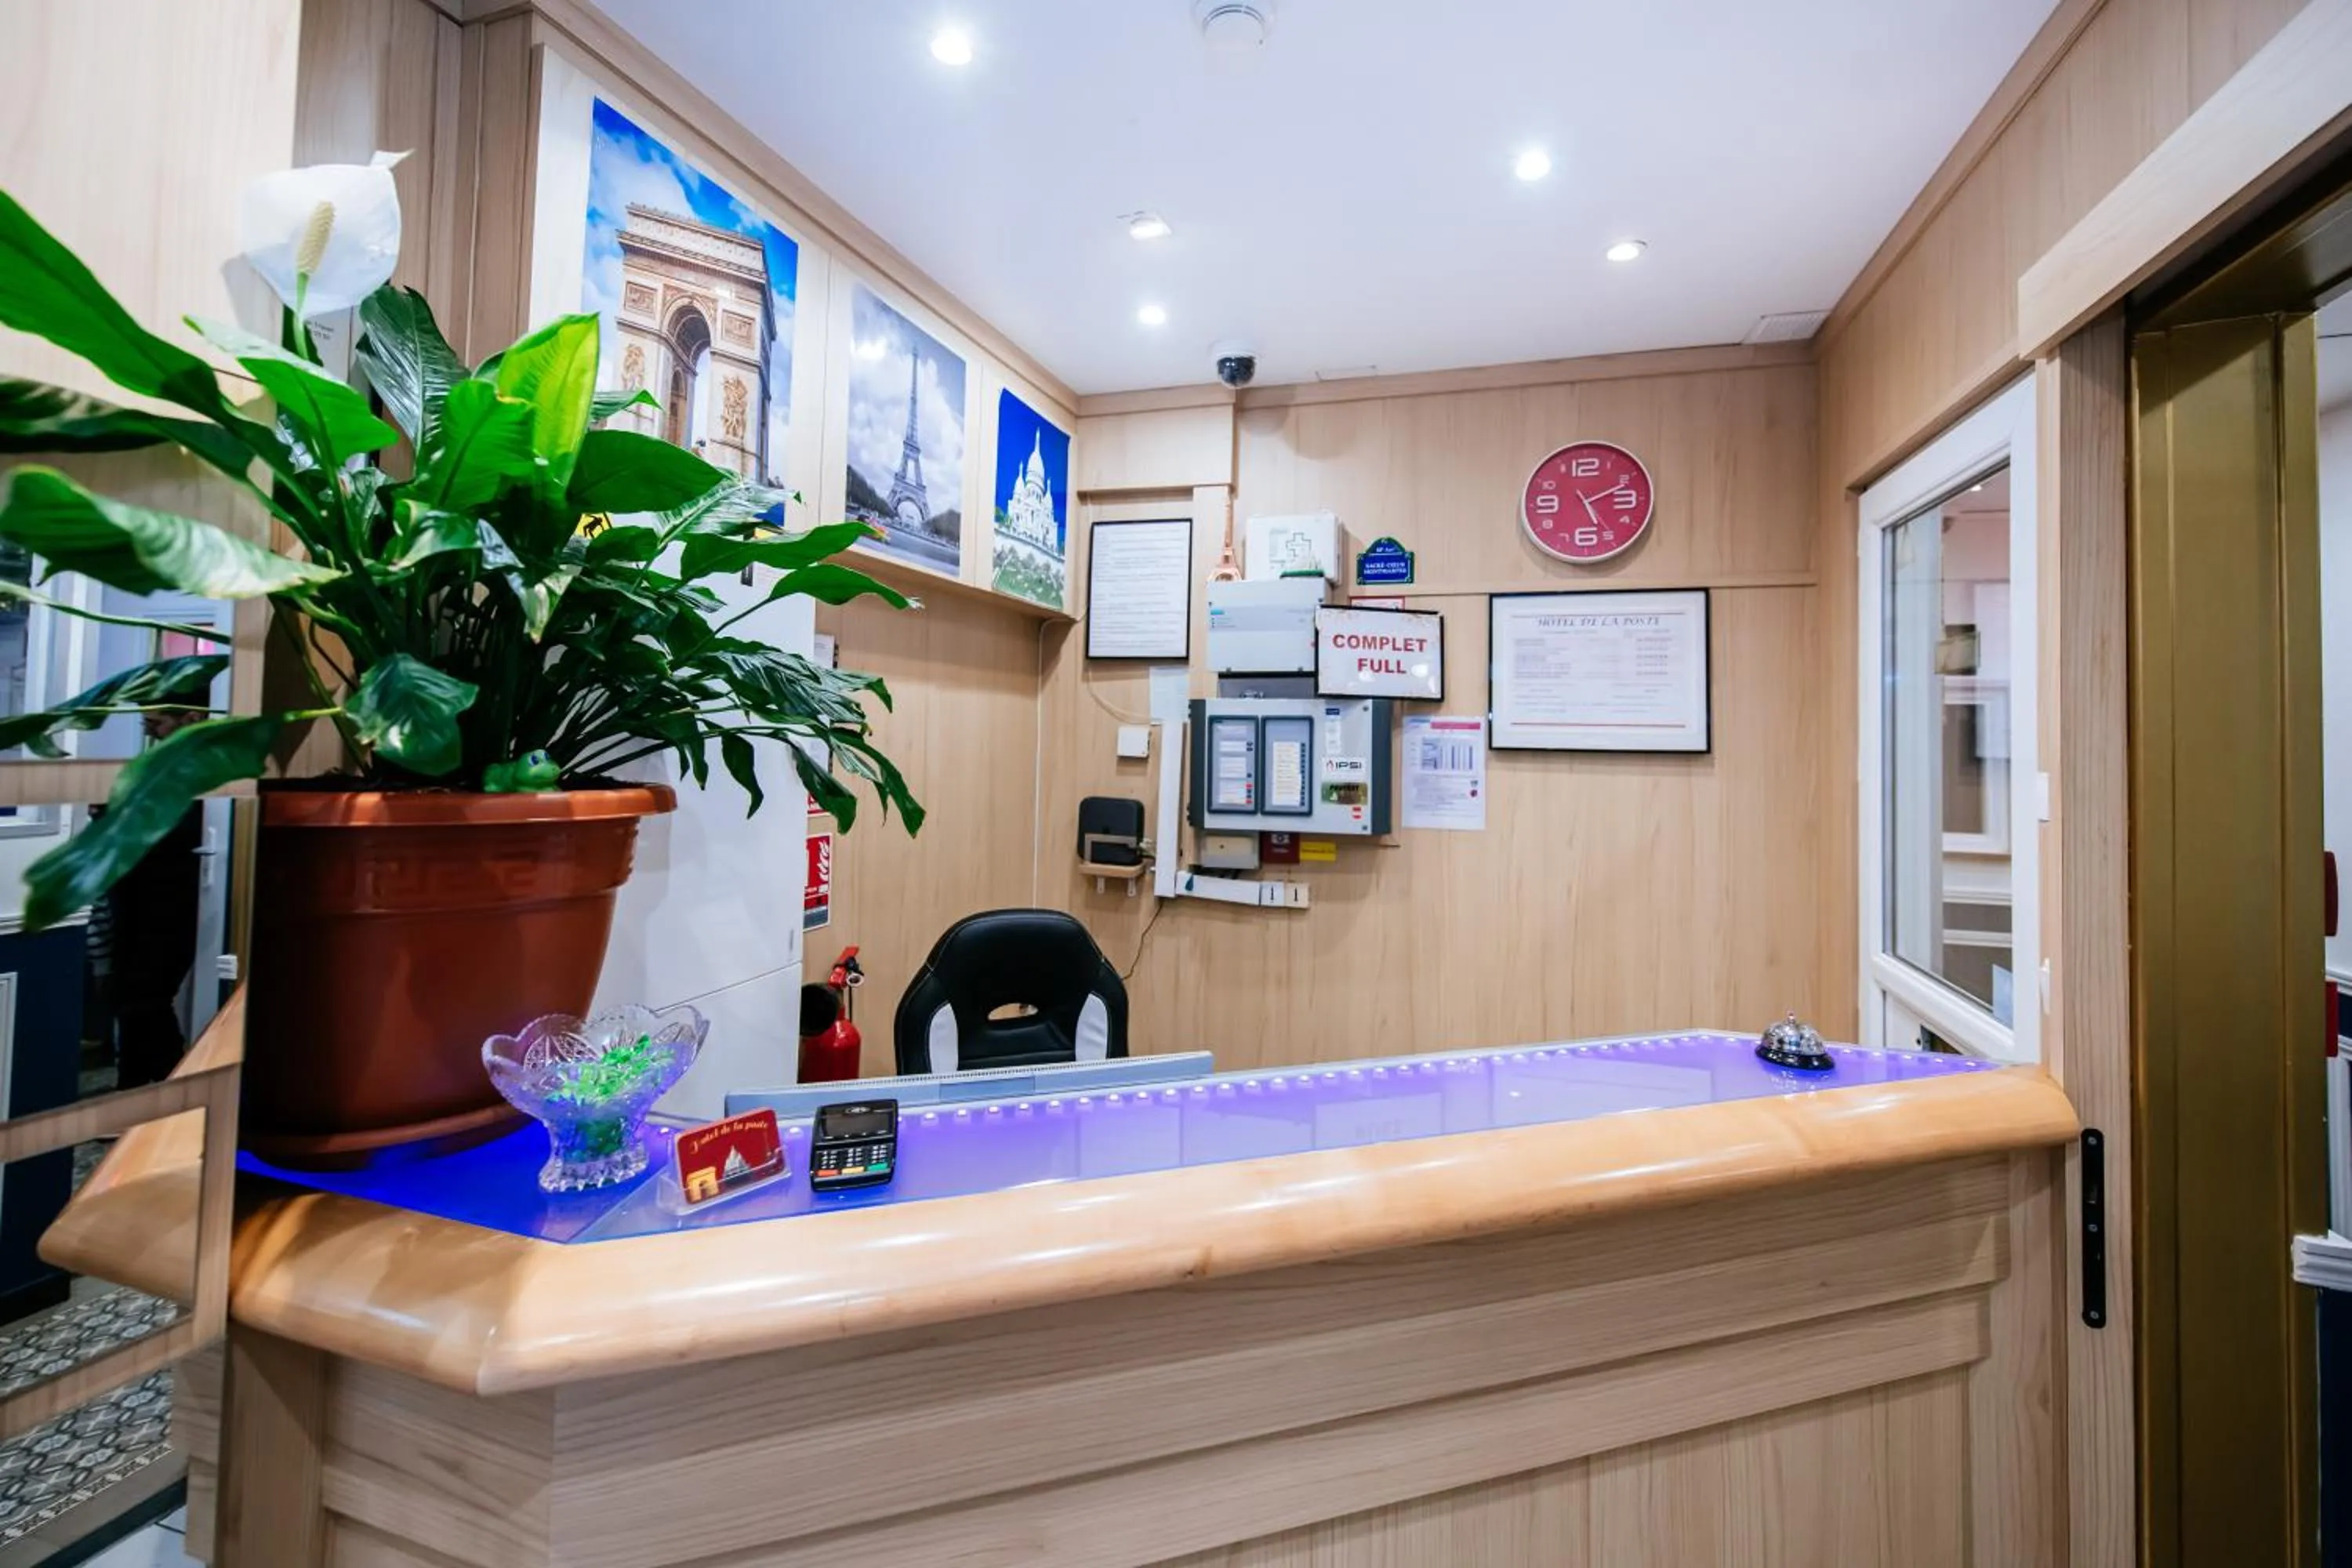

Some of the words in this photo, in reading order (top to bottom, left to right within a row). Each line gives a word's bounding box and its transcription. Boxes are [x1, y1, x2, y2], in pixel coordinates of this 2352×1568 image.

[1572, 458, 1600, 477] 12
[1541, 480, 1556, 490] 10
[1536, 495, 1559, 514] 9
[1613, 490, 1637, 510] 3
[1541, 519, 1554, 529] 8
[1619, 515, 1631, 524] 4
[1558, 532, 1570, 543] 7
[1574, 527, 1598, 546] 6
[1602, 530, 1615, 541] 5
[1332, 633, 1428, 653] COMPLET
[1357, 658, 1408, 674] FULL
